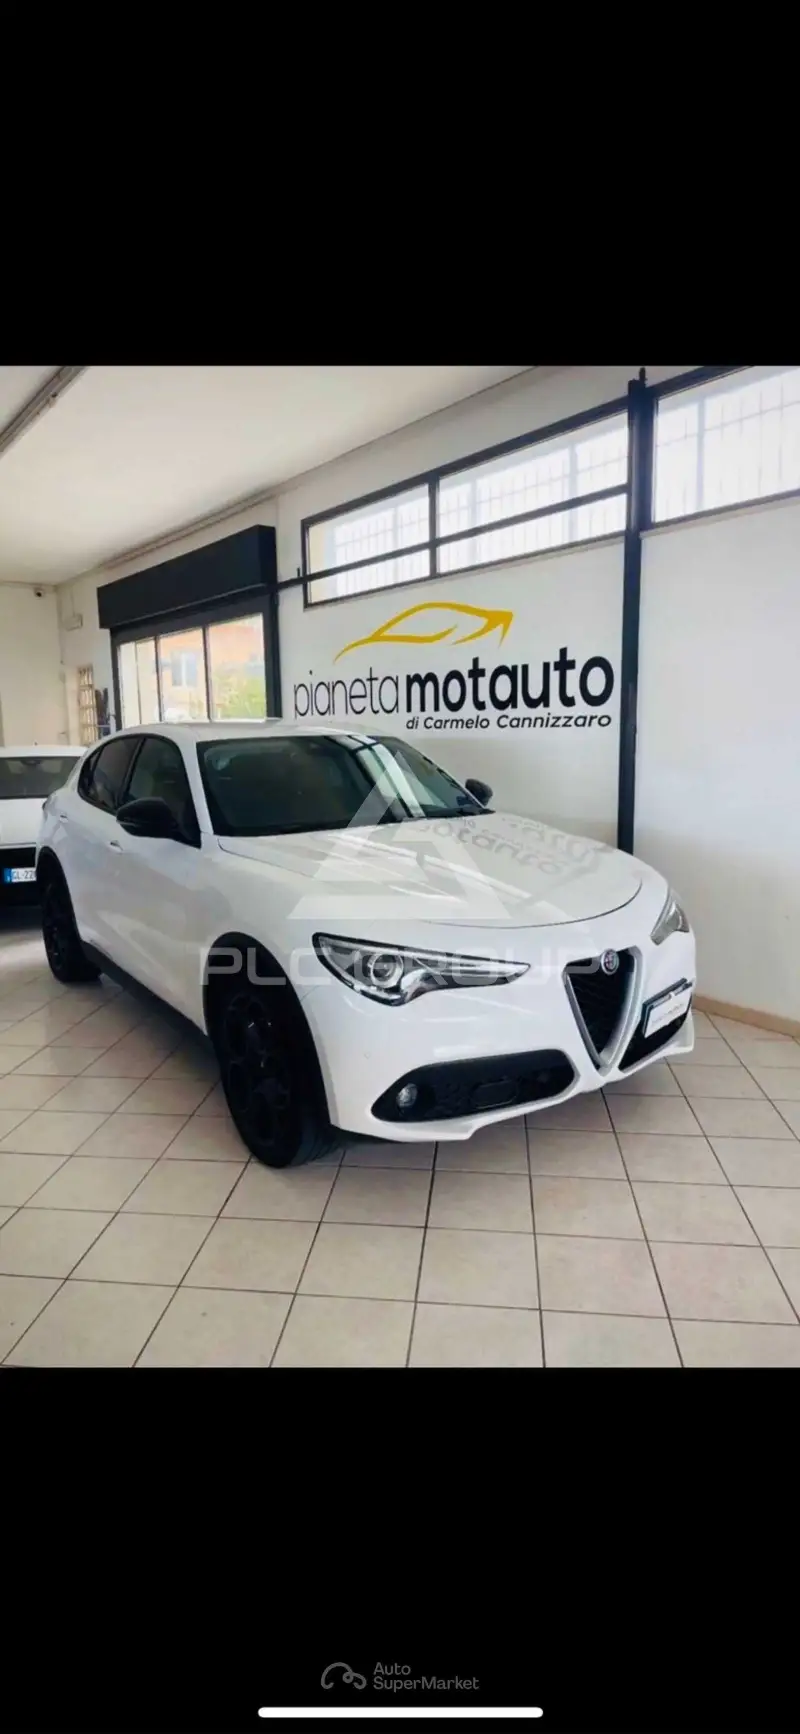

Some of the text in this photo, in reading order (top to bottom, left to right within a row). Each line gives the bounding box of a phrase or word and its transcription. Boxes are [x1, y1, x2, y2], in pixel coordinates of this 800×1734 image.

[293, 647, 615, 720] pianeta motauto
[405, 712, 613, 730] di Carmelo Cannizzaro
